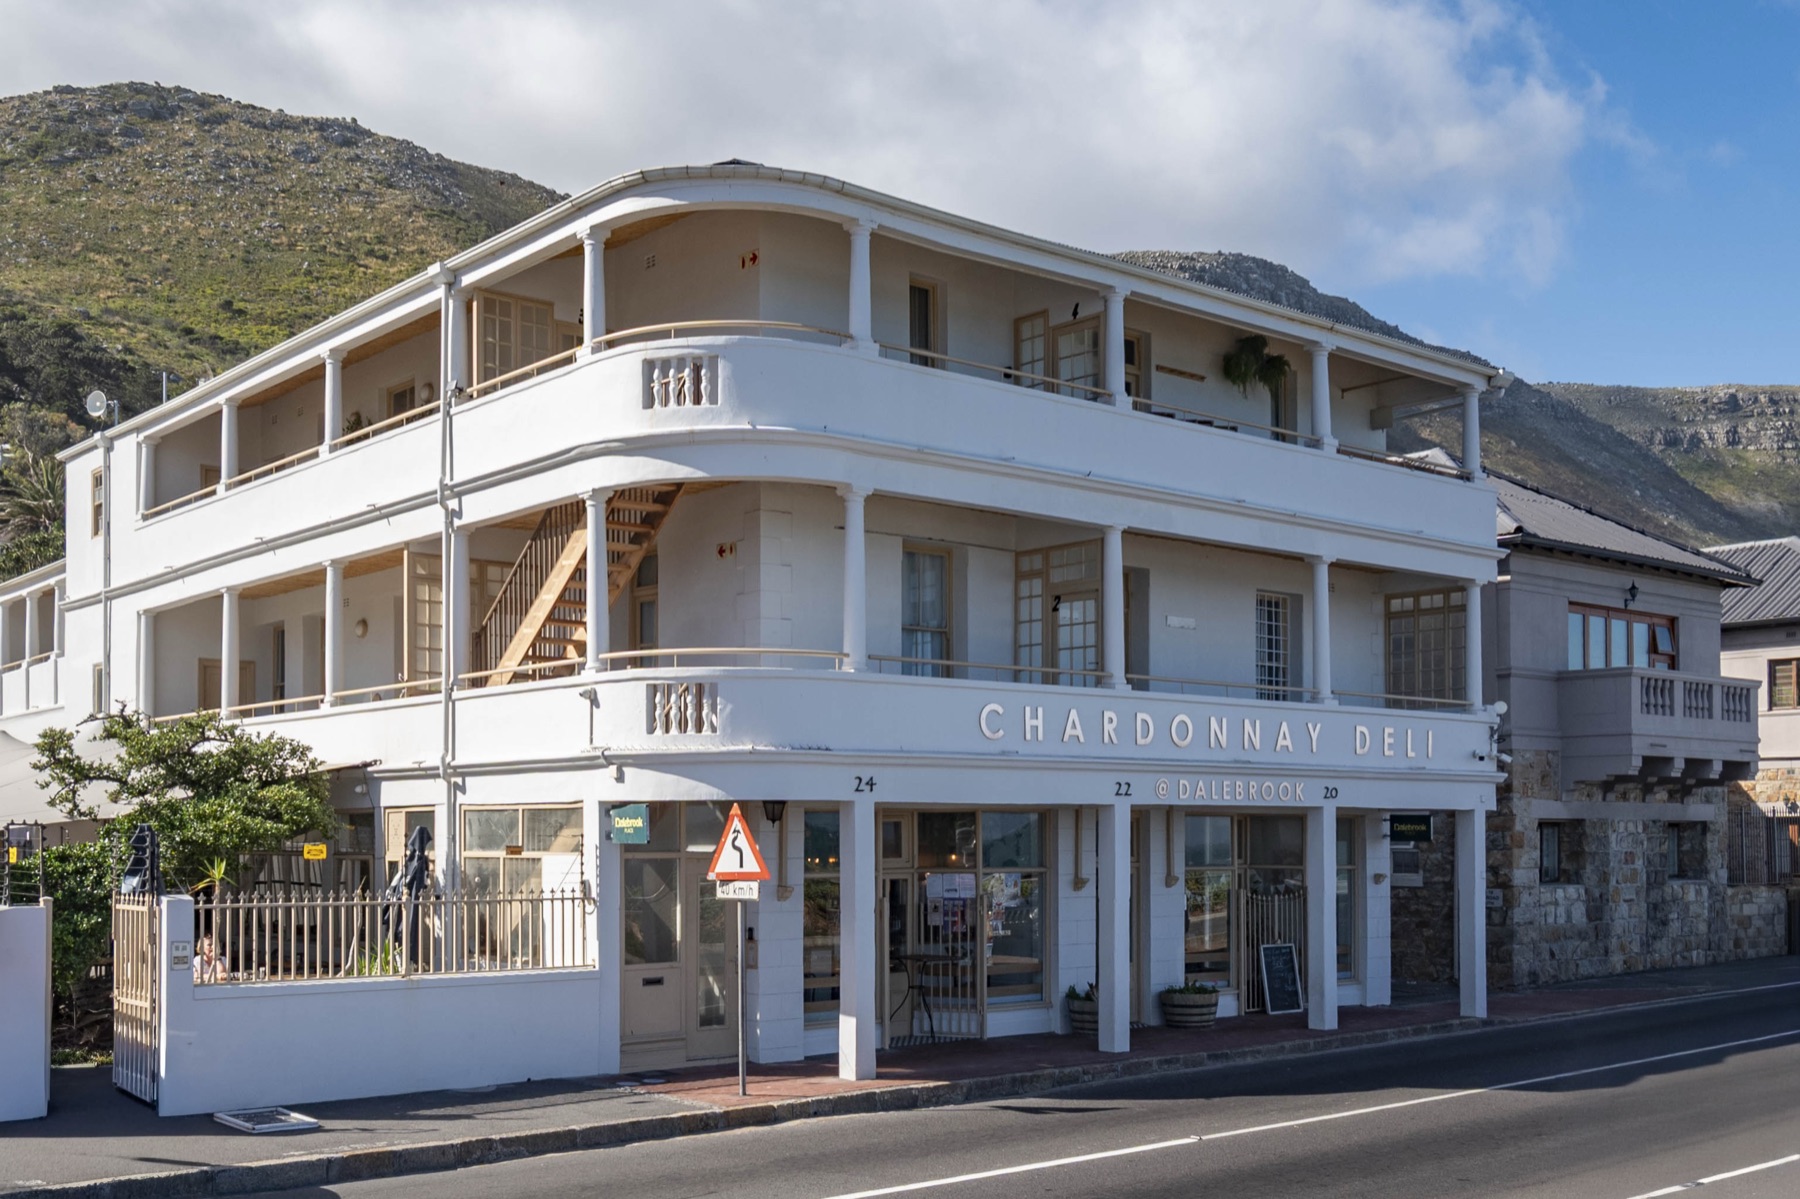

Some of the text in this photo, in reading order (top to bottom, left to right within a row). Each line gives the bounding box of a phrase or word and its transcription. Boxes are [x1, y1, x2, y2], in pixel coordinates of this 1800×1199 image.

[1052, 595, 1062, 612] 2
[979, 702, 1433, 759] CHARDONNAY DELI
[854, 775, 877, 793] 24
[1114, 781, 1133, 797] 22
[1323, 785, 1339, 799] 20
[720, 882, 754, 896] 40 km/h
